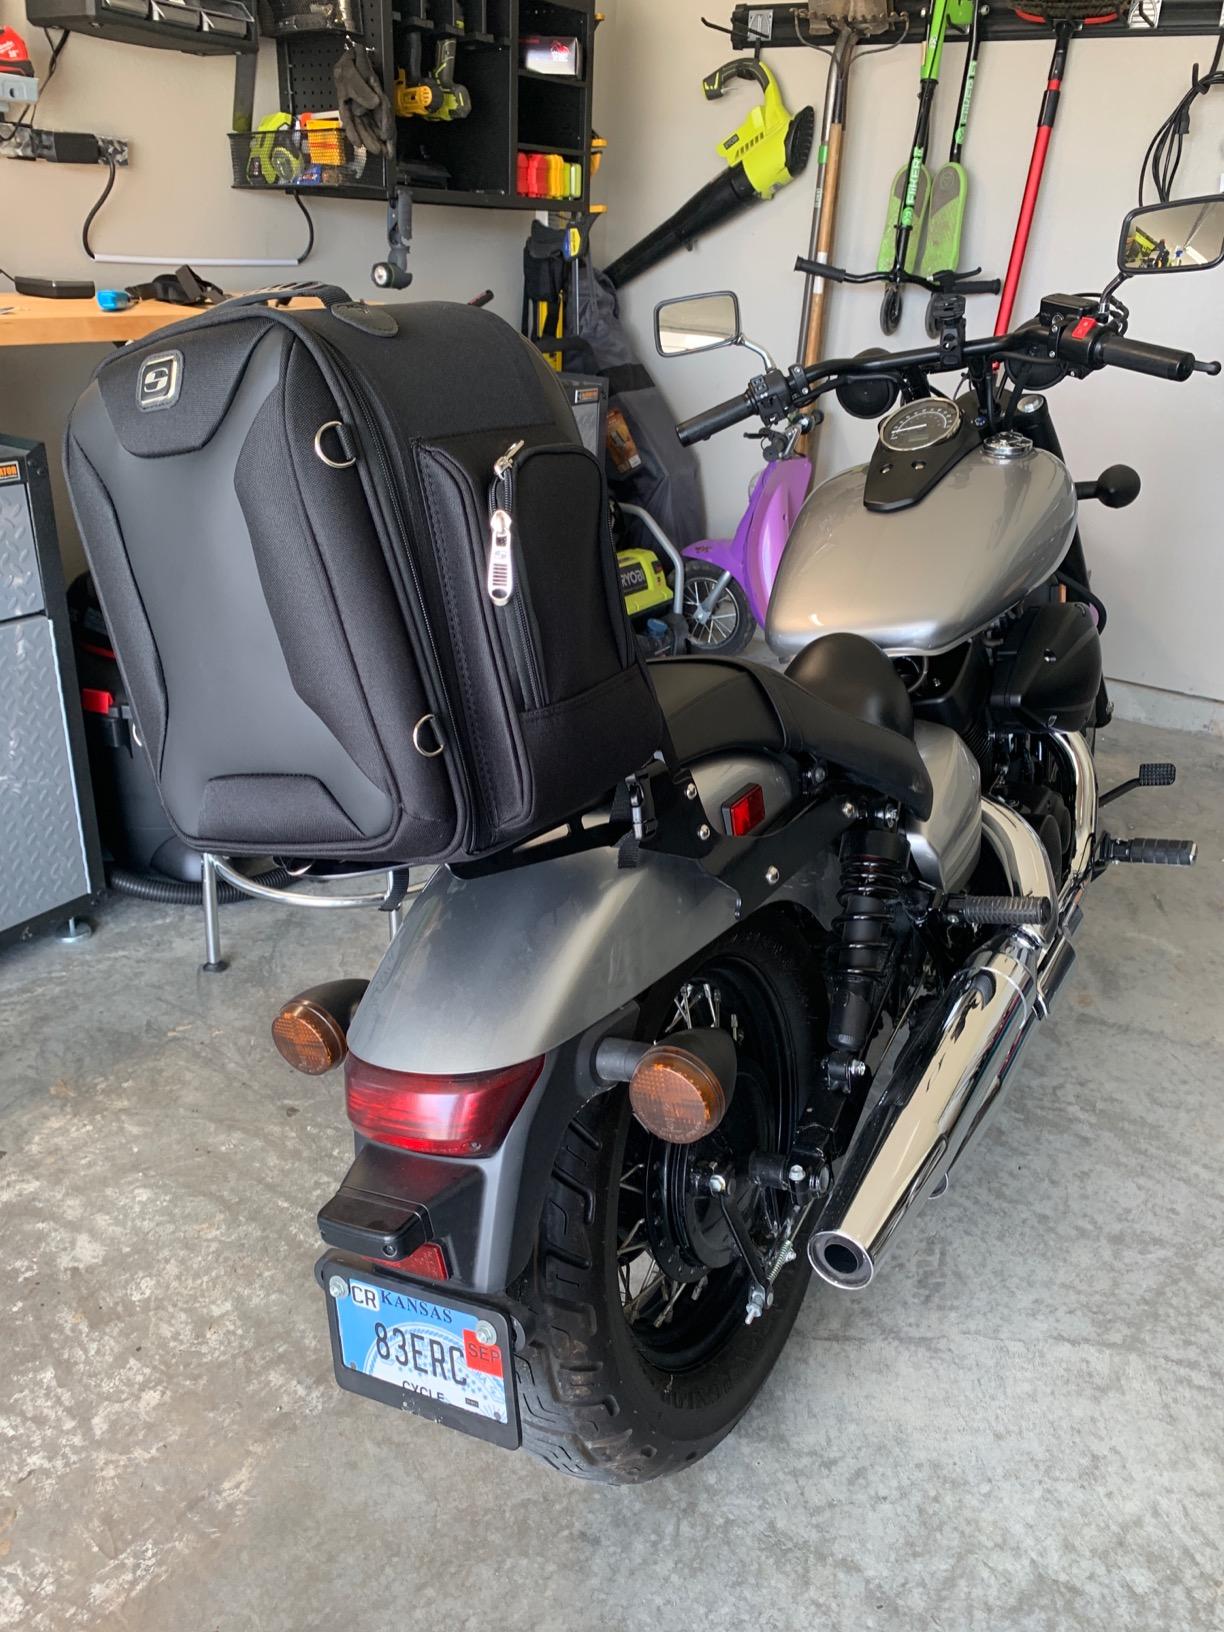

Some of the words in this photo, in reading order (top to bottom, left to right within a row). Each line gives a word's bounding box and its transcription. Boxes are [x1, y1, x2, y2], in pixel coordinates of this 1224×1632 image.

[351, 1284, 378, 1309] CR
[380, 1289, 454, 1324] KANSAS
[374, 1321, 468, 1386] 83ERC
[467, 1342, 500, 1362] SEP
